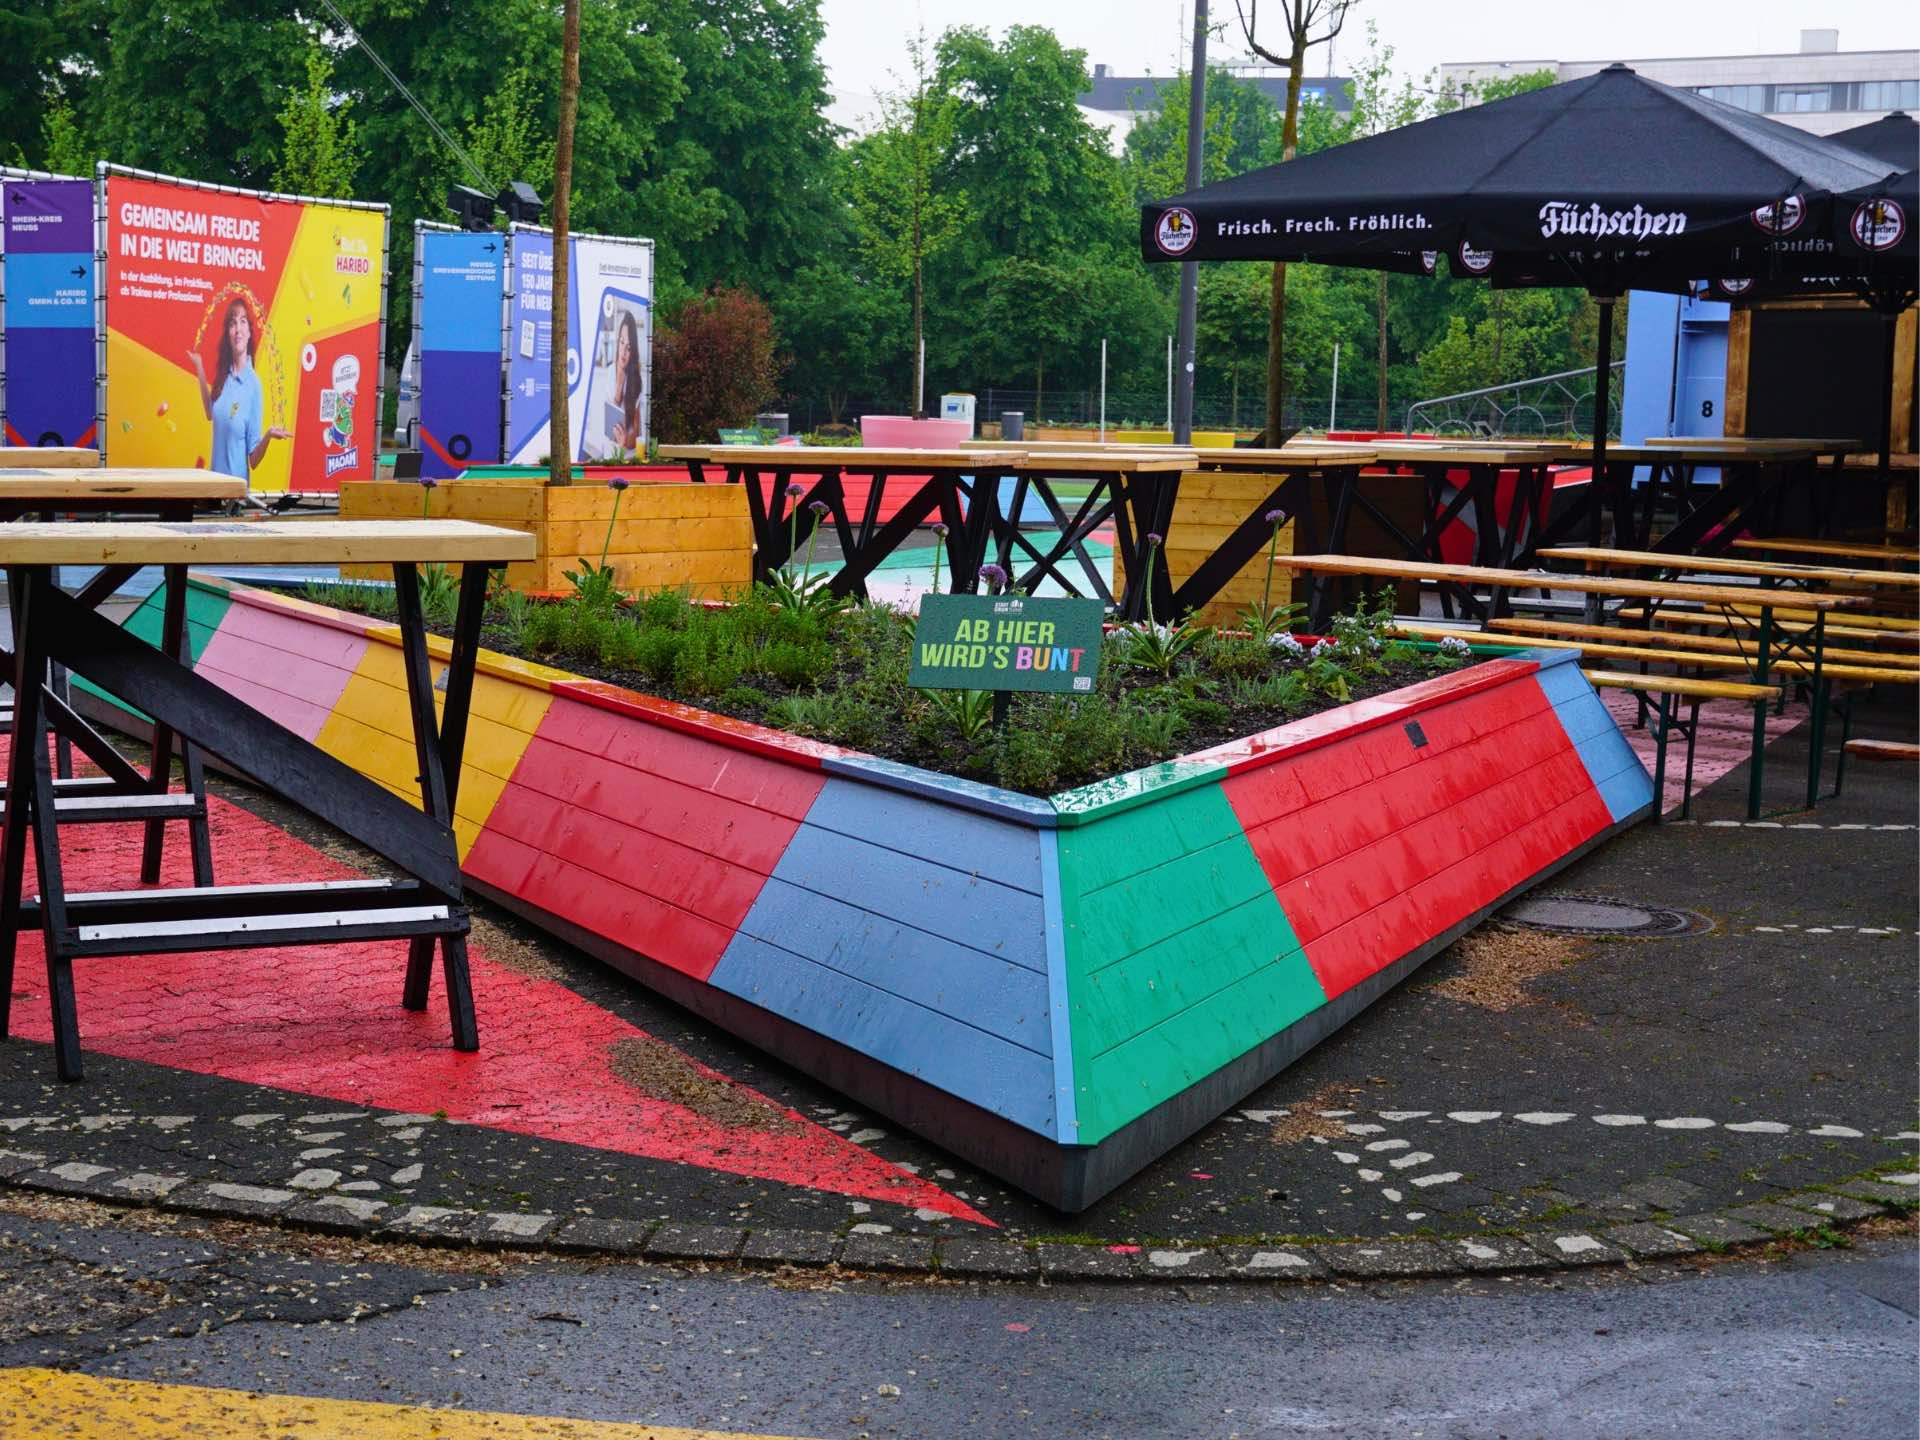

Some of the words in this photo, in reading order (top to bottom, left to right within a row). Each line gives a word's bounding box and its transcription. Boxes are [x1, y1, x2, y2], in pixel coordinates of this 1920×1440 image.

[120, 203, 207, 236] GEMEINSAM
[211, 216, 261, 242] FREUDE
[1218, 219, 1277, 235] Frisch.
[1285, 217, 1341, 233] Frech.
[1349, 213, 1433, 231] Fröhlich.
[1539, 201, 1687, 241] Füchschen
[120, 233, 137, 256] IN
[140, 236, 163, 260] DIE
[166, 239, 201, 264] WELT
[203, 244, 266, 271] BRINGEN.
[521, 251, 538, 269] SEIT
[538, 250, 553, 271] ÜBE
[336, 256, 369, 273] HARIBO
[522, 273, 535, 290] 150
[521, 290, 536, 310] FÜR
[536, 294, 552, 311] NEU
[1702, 400, 1713, 417] 8
[954, 619, 989, 643] AB
[996, 619, 1055, 645] HIER
[921, 643, 1010, 669] WIRD'S
[1016, 646, 1086, 672] BUNT
